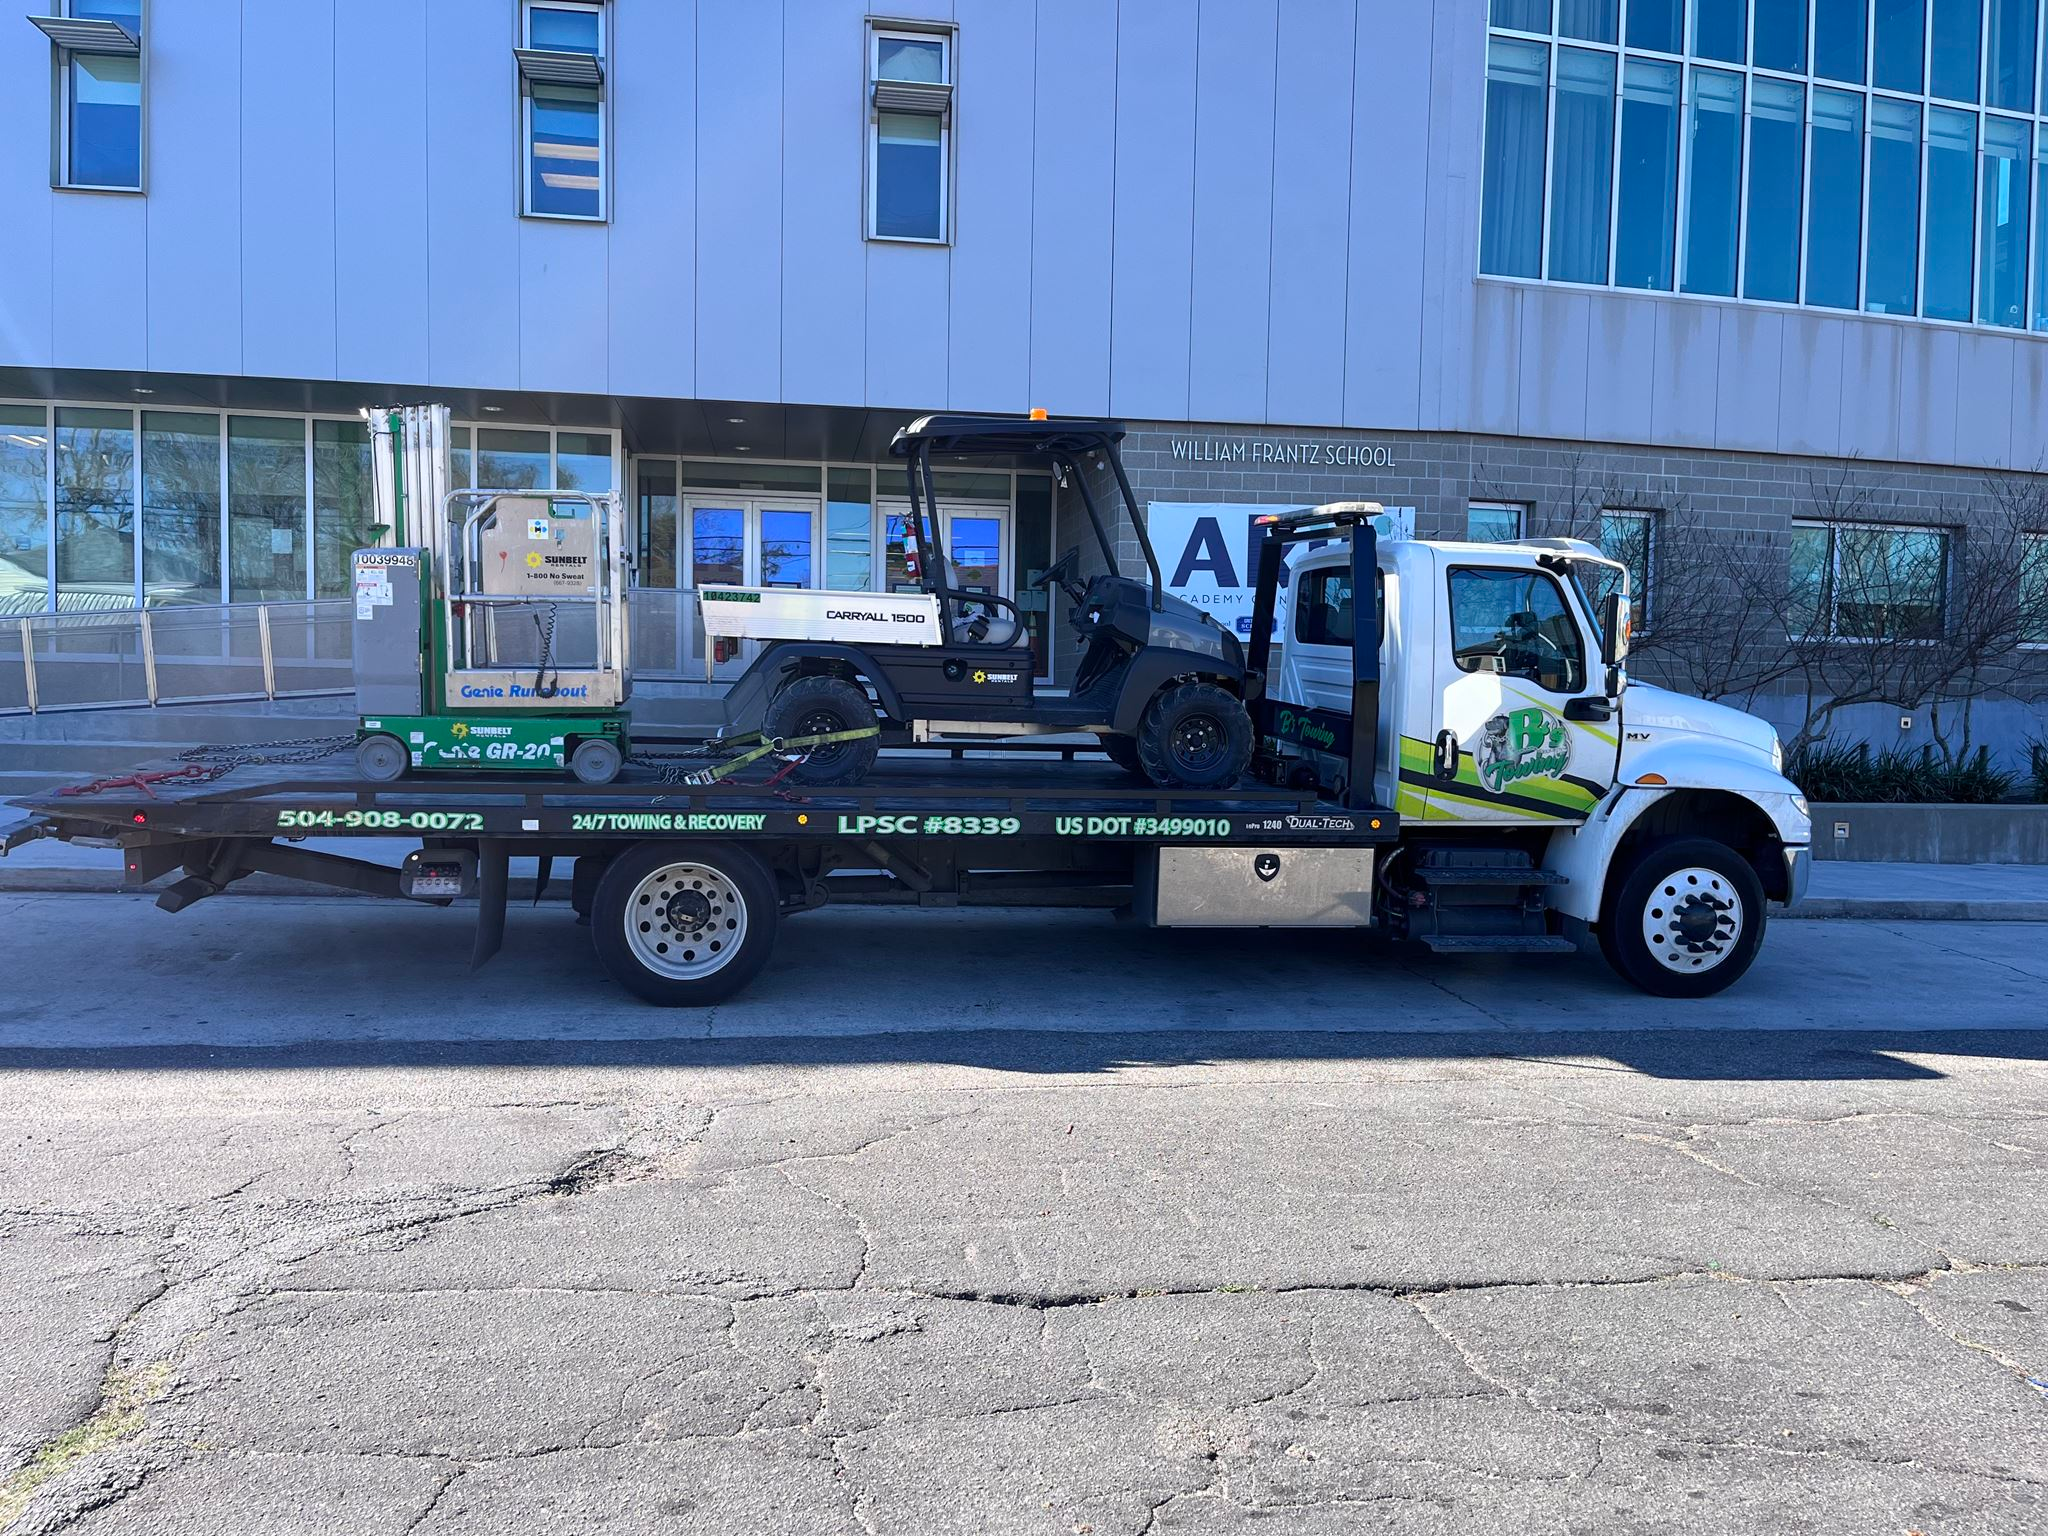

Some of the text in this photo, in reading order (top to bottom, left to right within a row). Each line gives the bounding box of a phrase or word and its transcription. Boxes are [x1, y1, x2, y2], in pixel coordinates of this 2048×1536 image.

[1171, 440, 1396, 467] WILLIAM FRANTZ SCHOOL
[545, 556, 587, 564] SUNBELT
[703, 591, 760, 602] 10423742
[1179, 594, 1244, 604] CADEMY
[826, 610, 925, 623] CARRYALL 1500
[461, 685, 504, 698] Genie
[470, 726, 512, 735] SUNBELT
[1298, 717, 1336, 749] Towing
[1627, 732, 1651, 740] MV
[1485, 751, 1569, 791] Towing
[277, 810, 484, 830] 504-908-0072
[572, 814, 766, 830] 24/7 TOWING & RECOVERY
[838, 815, 1021, 835] LPSC #8339
[1055, 816, 1230, 836] US DOT #3499010
[1262, 820, 1282, 830] 1240
